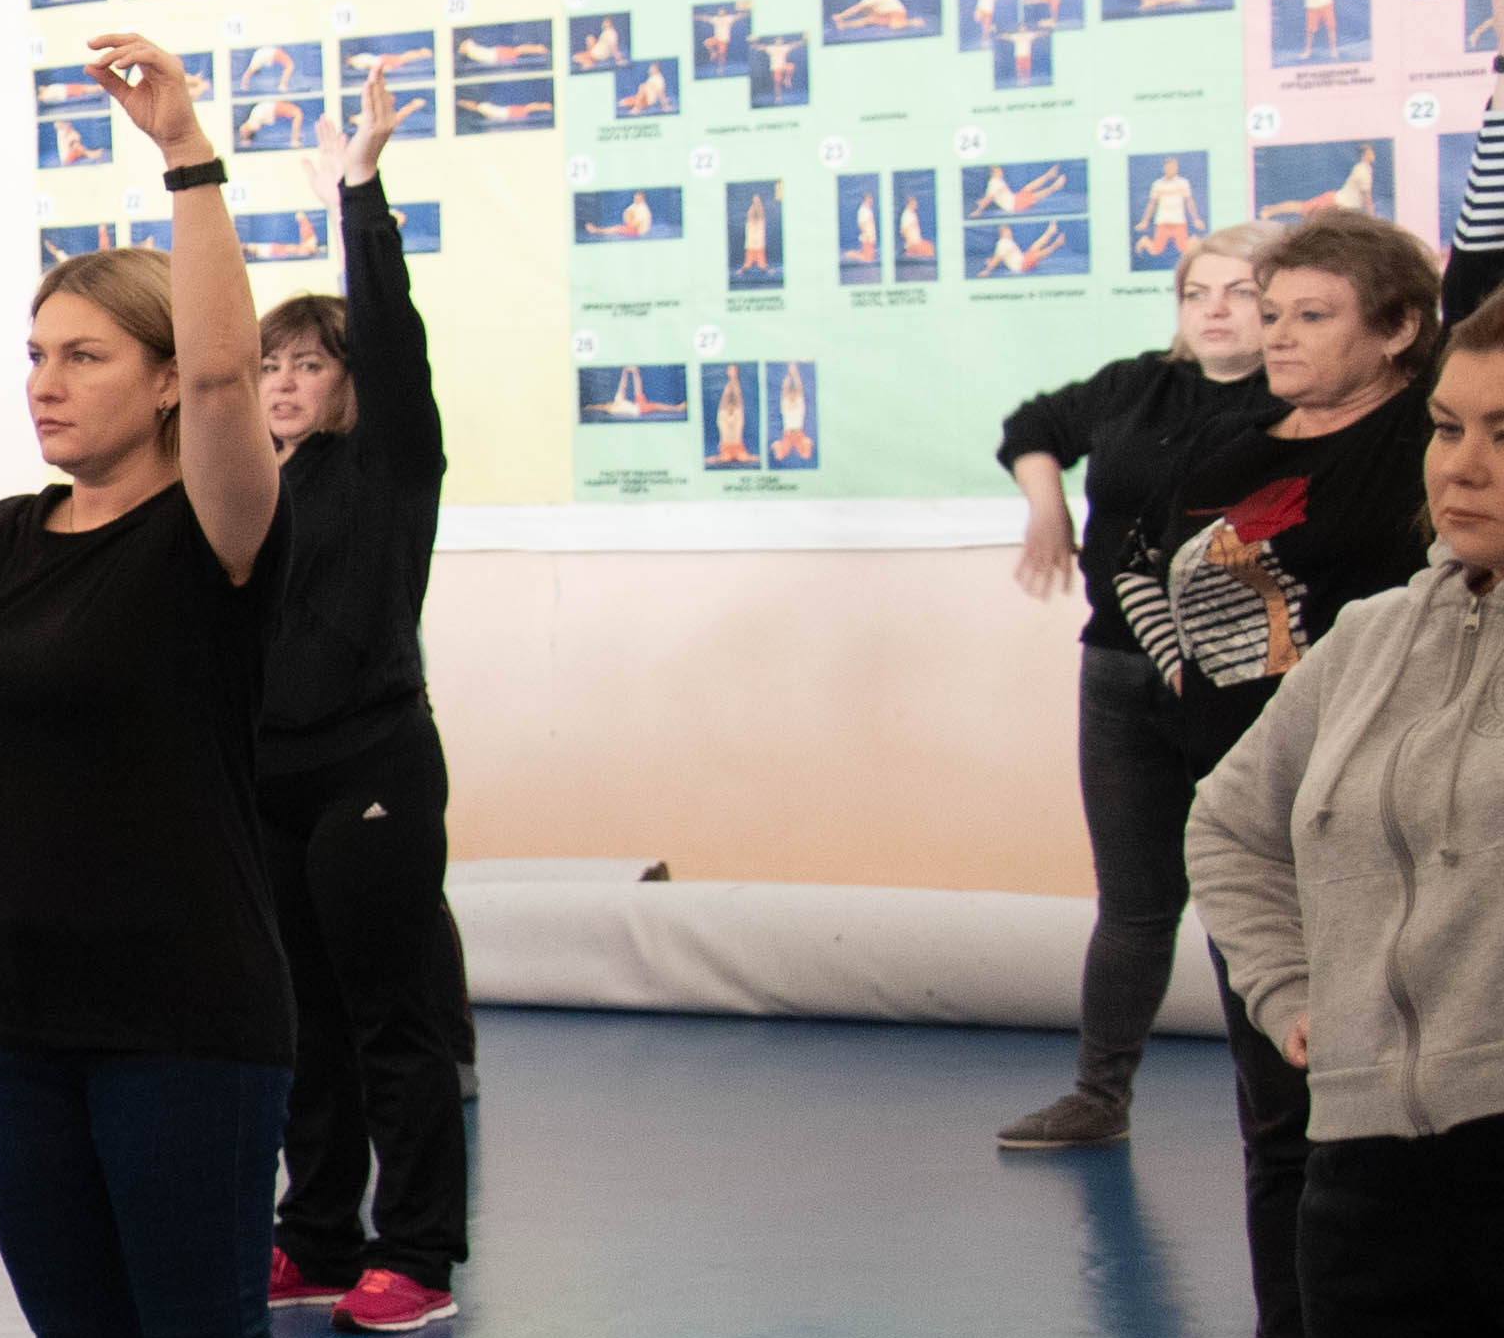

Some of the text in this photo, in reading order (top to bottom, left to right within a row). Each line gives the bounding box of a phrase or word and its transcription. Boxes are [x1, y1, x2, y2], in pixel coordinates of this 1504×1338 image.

[1411, 101, 1435, 120] 22
[1253, 113, 1274, 131] 21
[1104, 123, 1125, 141] 25
[960, 135, 981, 151] 24
[825, 144, 844, 160] 23
[695, 153, 714, 170] 22
[571, 162, 589, 179] 21
[576, 337, 595, 353] 26
[699, 331, 719, 349] 27
